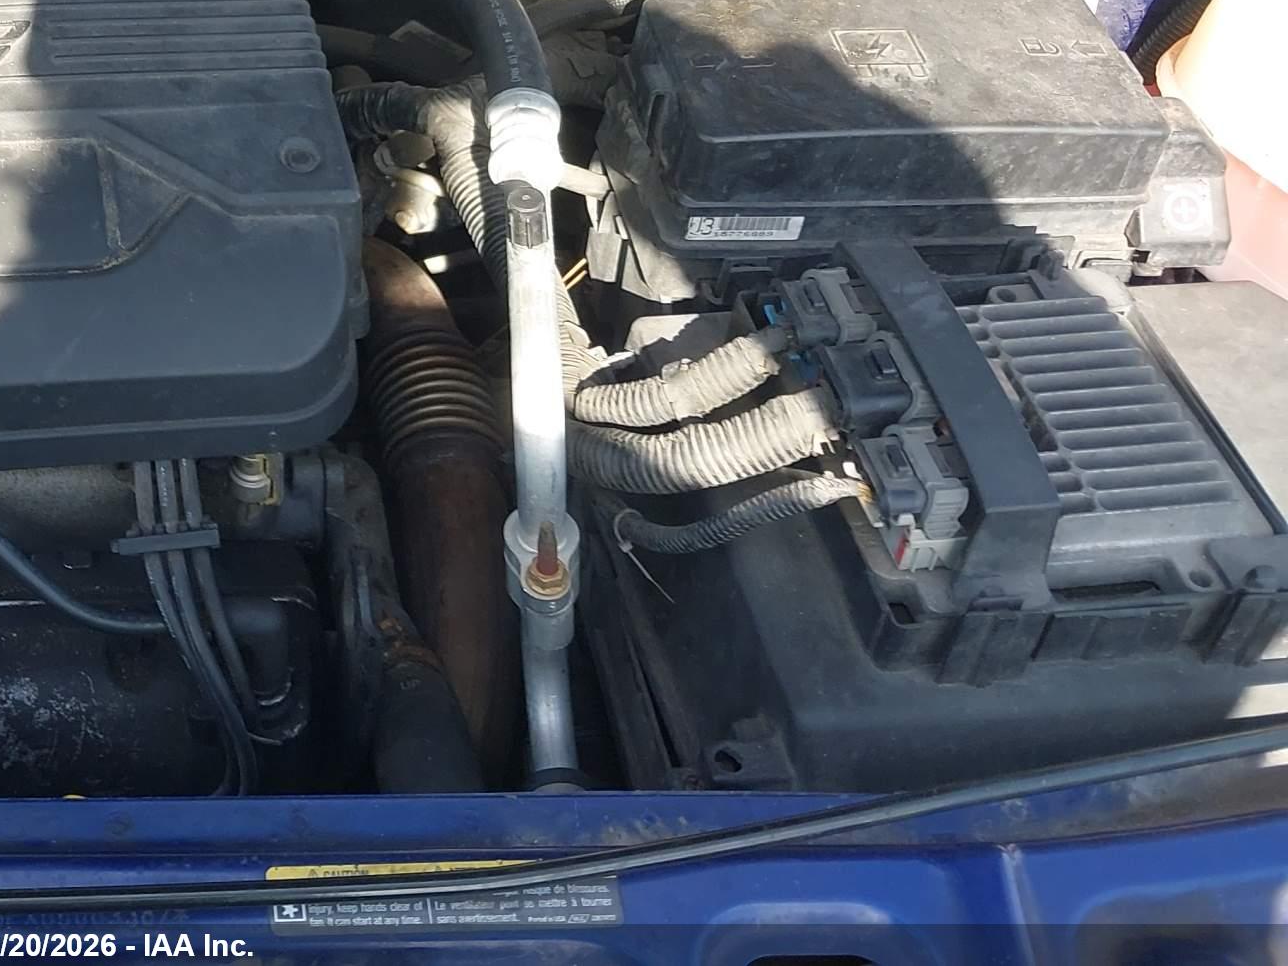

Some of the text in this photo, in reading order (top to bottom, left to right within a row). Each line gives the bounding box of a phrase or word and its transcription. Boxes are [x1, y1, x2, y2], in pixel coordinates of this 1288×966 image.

[553, 885, 565, 893] de
[336, 904, 358, 913] keep
[361, 903, 387, 912] hands
[390, 902, 410, 911] clear
[413, 901, 423, 911] of
[434, 901, 448, 910] Le
[352, 916, 371, 925] start
[373, 916, 382, 924] at
[384, 917, 399, 926] any
[437, 915, 457, 923] sans
